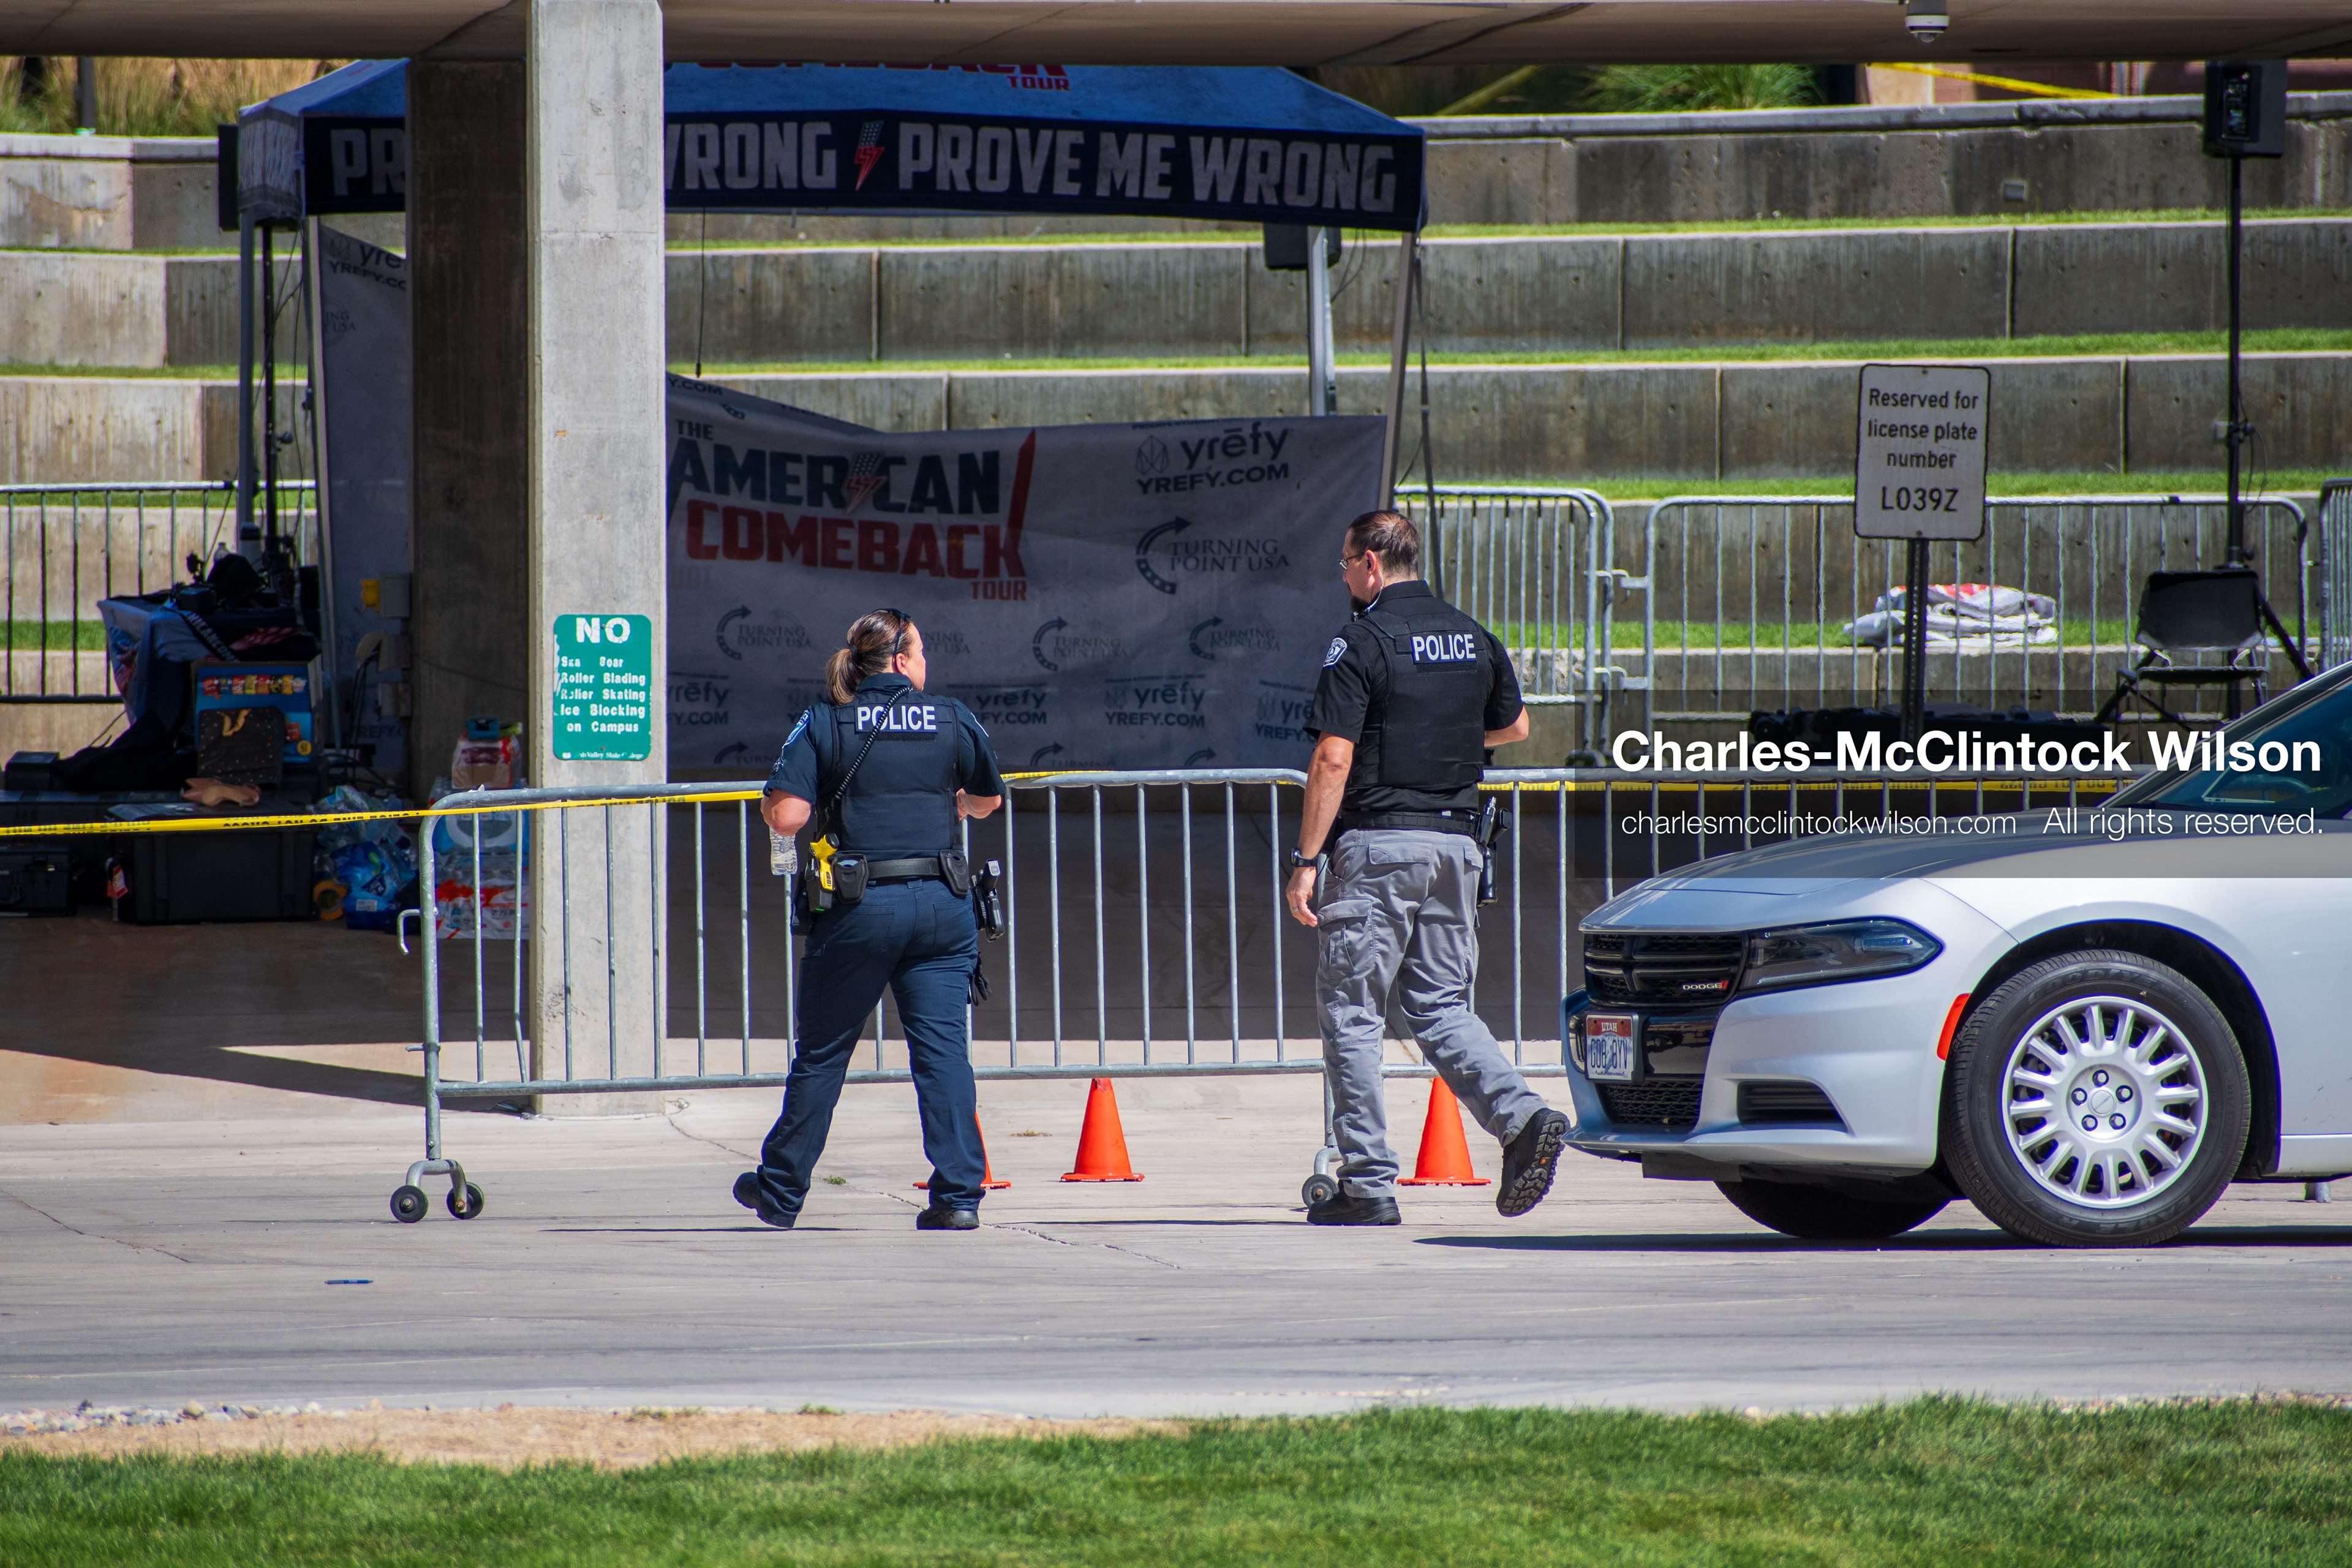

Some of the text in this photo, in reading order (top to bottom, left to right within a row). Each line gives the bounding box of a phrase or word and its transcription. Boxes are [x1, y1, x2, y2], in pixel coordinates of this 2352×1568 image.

[1008, 75, 1070, 91] TOUR
[666, 122, 837, 190] RONG
[898, 123, 1085, 196] PROVE
[1096, 132, 1175, 200] ME
[1189, 137, 1396, 213] WRONG
[1869, 388, 1978, 409] Reserved for
[676, 420, 714, 440] THE
[1868, 420, 1978, 443] license plate
[1887, 450, 1956, 469] number
[1137, 462, 1289, 494] YREFY.COM
[686, 497, 1027, 579] COMEBACK
[1169, 539, 1278, 556] TURNING
[1170, 554, 1289, 571] POINT USA
[971, 580, 1027, 601] TOUR
[576, 617, 630, 644] NO
[737, 624, 805, 637] TURNING
[1210, 628, 1276, 641] TURNING
[737, 635, 812, 648] POINT USA
[946, 643, 971, 654] USA
[1054, 636, 1121, 647] TURNING
[1210, 639, 1281, 652] POINT USA
[1412, 633, 1476, 661] POLICE
[1054, 646, 1095, 658] POINT
[561, 672, 646, 686] Roller Blading
[602, 688, 646, 703] Skating
[560, 704, 646, 719] Ice Blocking
[857, 705, 937, 730] POLICE
[1104, 711, 1205, 728] YREFY.COM
[567, 721, 639, 734] on Campus
[1601, 1022, 1618, 1033] UTAH
